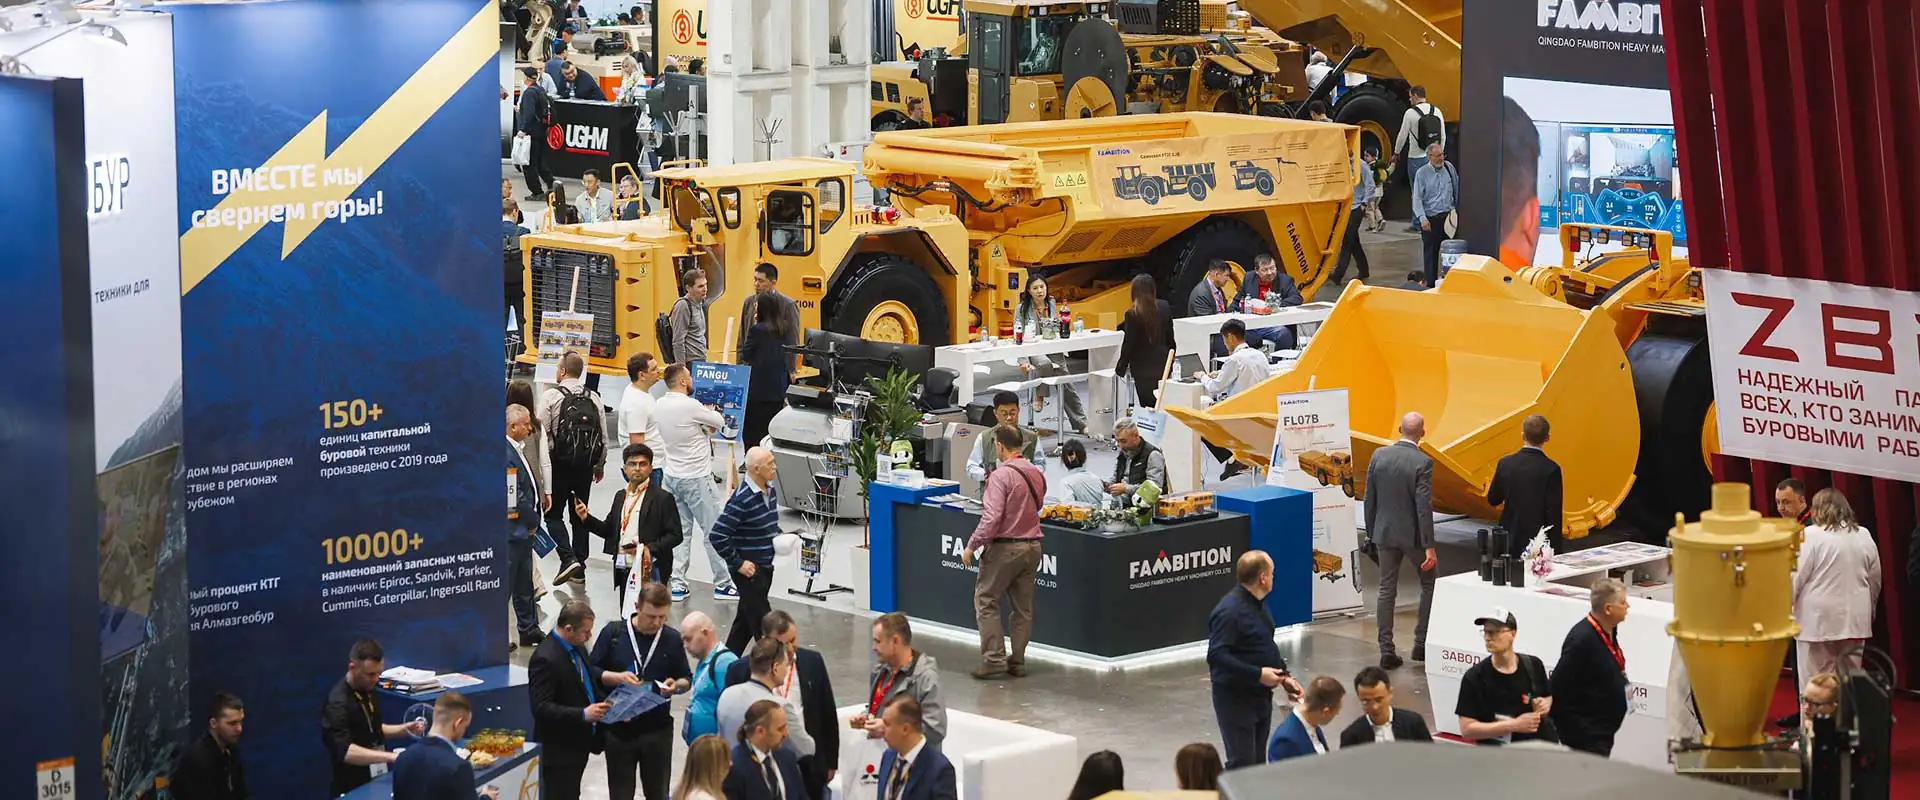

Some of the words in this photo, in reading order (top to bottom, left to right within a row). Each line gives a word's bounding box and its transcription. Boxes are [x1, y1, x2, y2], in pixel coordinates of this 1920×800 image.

[1538, 36, 1575, 48] QINGDAO
[1577, 39, 1620, 50] FAMBITION
[1623, 42, 1649, 53] HEAVY
[566, 124, 609, 150] UGHM
[93, 157, 130, 213] БУР
[211, 164, 318, 195] ВМЕСТЕ
[323, 166, 363, 187] мы
[191, 203, 305, 231] свернем
[312, 191, 383, 224] горы!
[1286, 222, 1310, 275] FAMBITION
[95, 284, 132, 303] техники
[133, 279, 150, 296] для
[1731, 292, 1920, 374] ZB
[697, 370, 728, 380] PANGU
[1738, 368, 1864, 401] НАДЕЖНЫЙ
[319, 399, 383, 429] 150+
[1284, 414, 1319, 426] FL07B
[1740, 392, 1797, 419] ВСЕХ,
[1803, 402, 1843, 423] КТО
[320, 434, 359, 447] единиц
[361, 422, 431, 441] капитальной
[1743, 417, 1864, 450] БУРОВЫМИ
[212, 465, 229, 475] мы
[231, 456, 294, 475] расширяем
[320, 446, 366, 464] буровой
[369, 443, 410, 456] техники
[320, 460, 389, 479] произведено
[390, 460, 397, 469] с
[399, 454, 422, 468] 2019
[424, 452, 448, 464] года
[218, 481, 225, 490] в
[227, 474, 278, 491] регионах
[321, 528, 424, 565] 10000+
[322, 560, 402, 582] наименований
[404, 554, 456, 572] запасных
[457, 548, 494, 561] частей
[1129, 546, 1231, 579] FAMBITION
[210, 581, 257, 598] процент
[260, 576, 281, 590] КТГ
[322, 588, 329, 597] в
[331, 582, 378, 595] наличии:
[380, 576, 413, 591] Epiroc,
[415, 569, 456, 585] Sandvik,
[458, 564, 492, 578] Parker,
[322, 597, 372, 614] Cummins,
[374, 588, 428, 605] Caterpillar,
[430, 582, 474, 599] Ingersoll
[475, 577, 501, 591] Rand
[202, 611, 275, 631] Алмазгеобур
[1442, 650, 1481, 665] ЗАВОД
[43, 781, 71, 798] 3015
